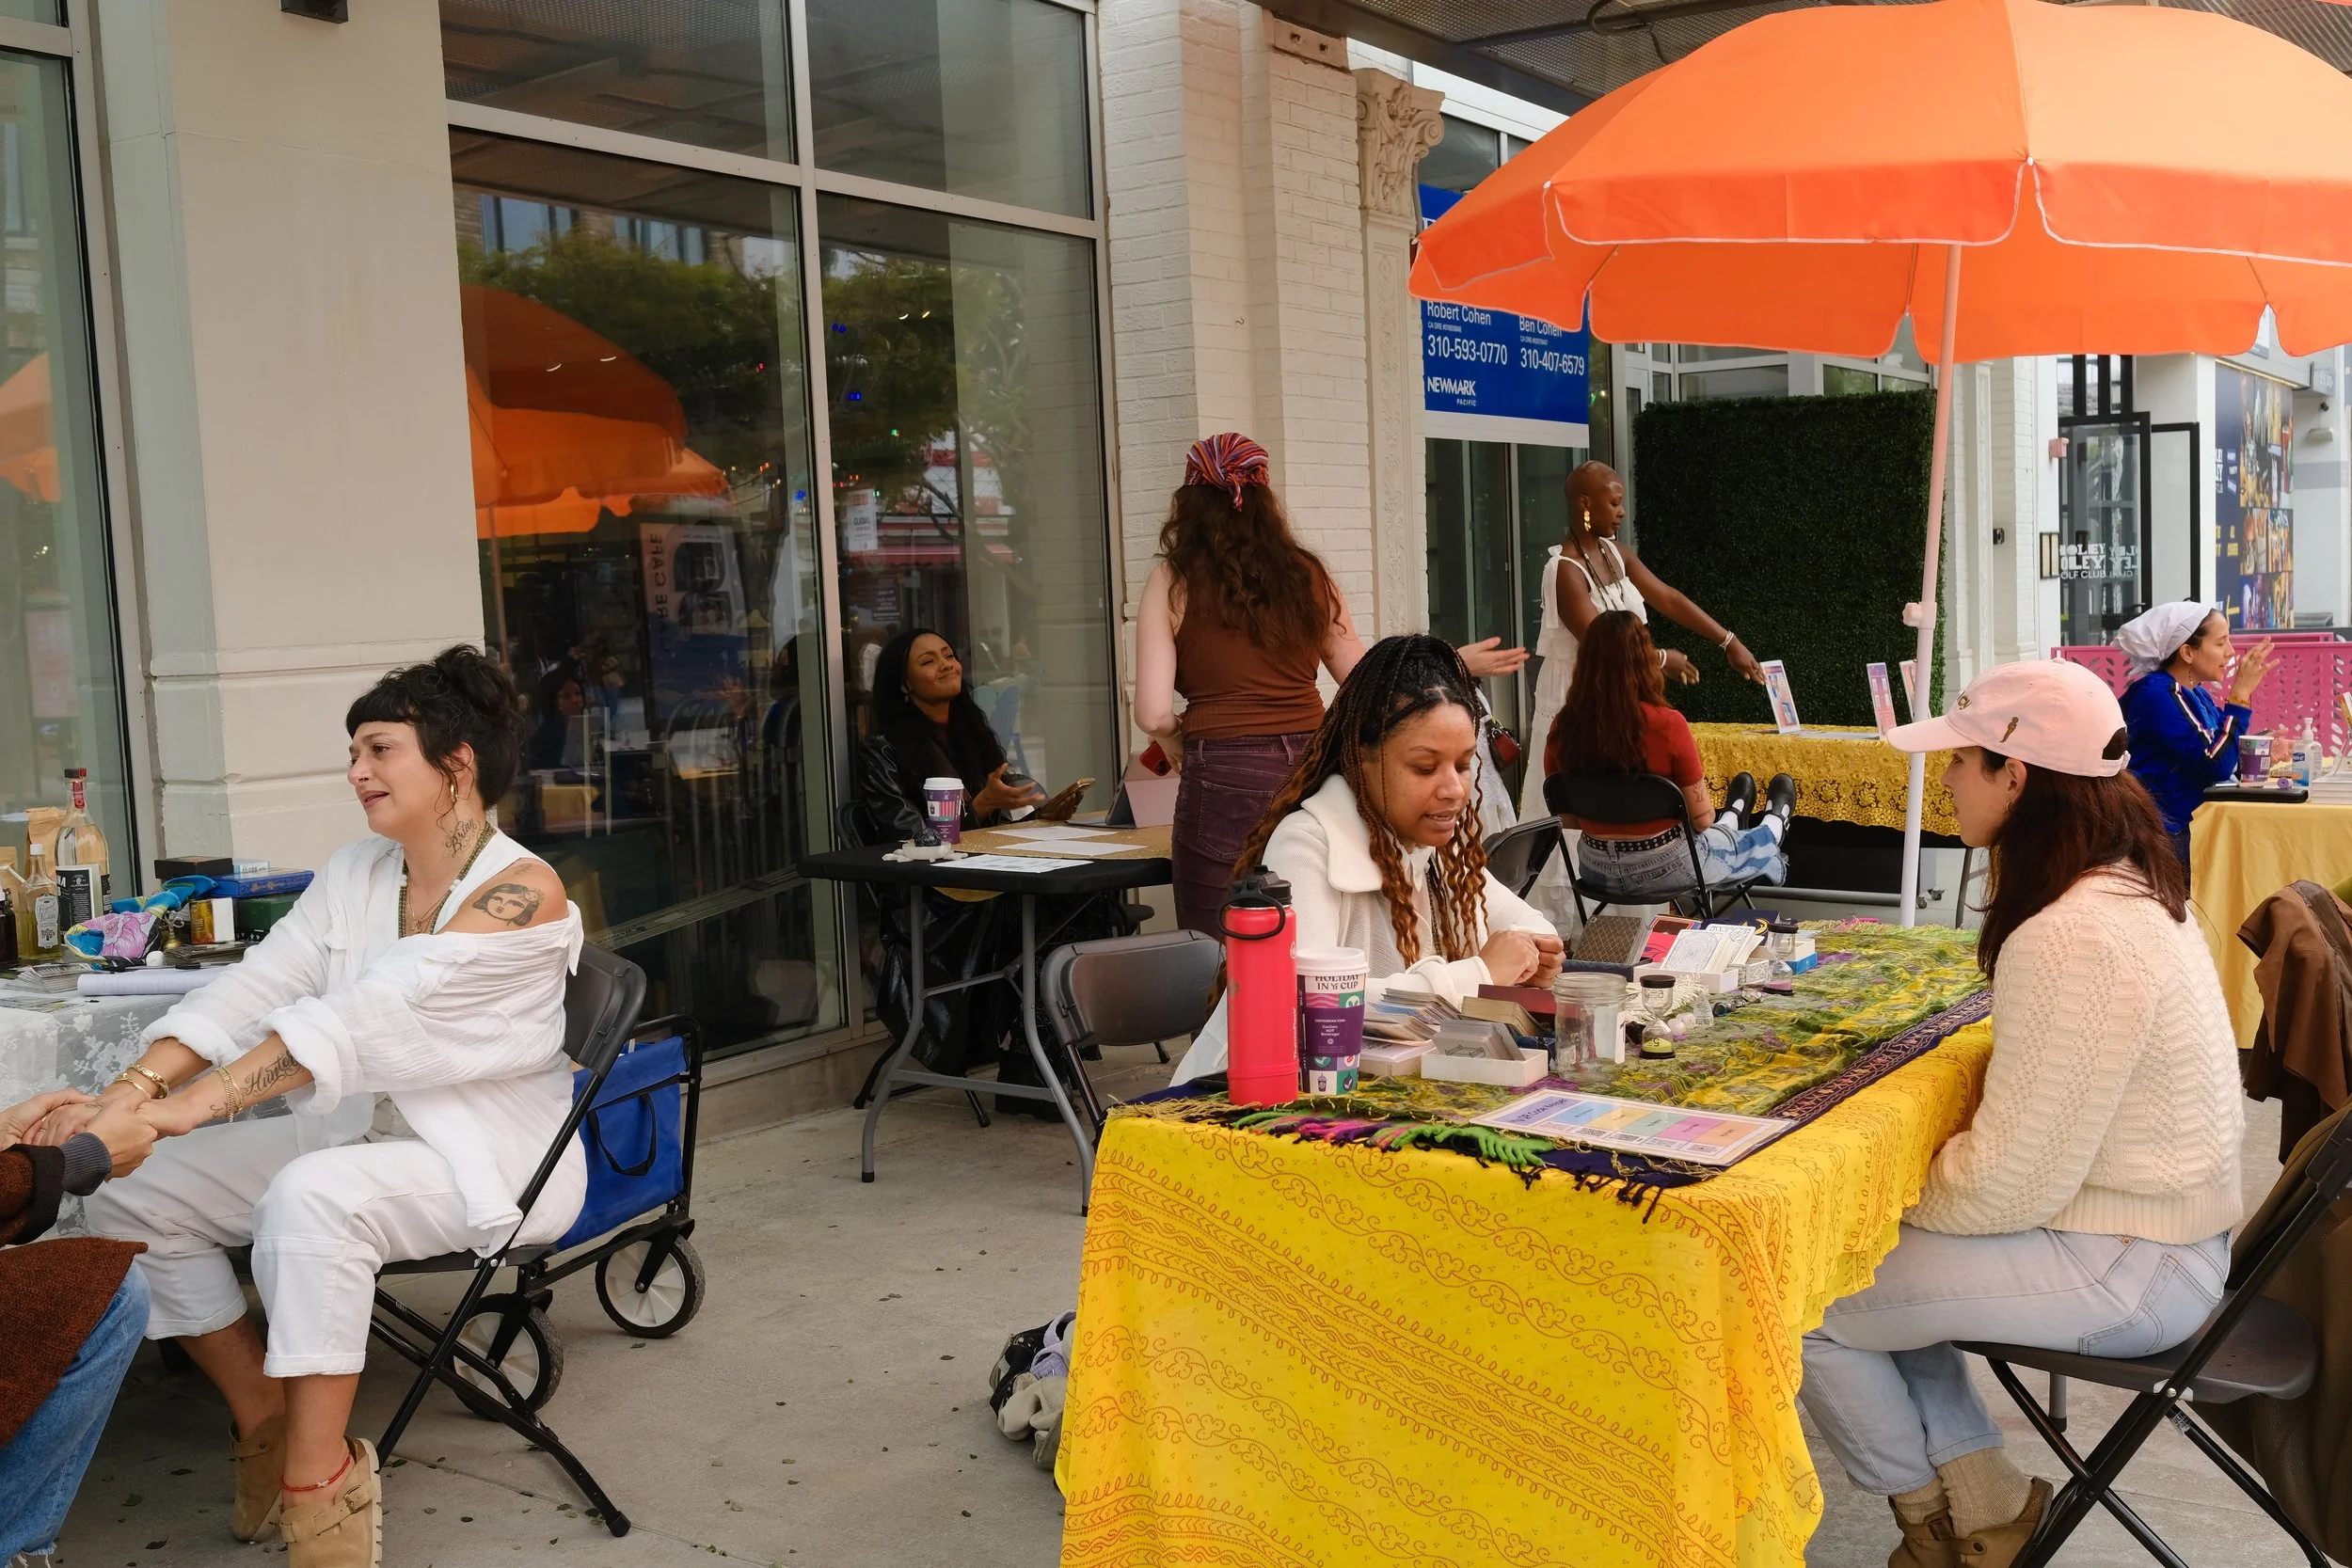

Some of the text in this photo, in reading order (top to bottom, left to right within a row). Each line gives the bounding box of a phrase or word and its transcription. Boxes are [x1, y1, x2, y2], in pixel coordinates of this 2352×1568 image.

[1427, 300, 1491, 325] Robert Cohen
[1519, 316, 1535, 333] Ben
[1428, 334, 1507, 365] 310-593-0770
[1520, 347, 1584, 375] 310-407-6579
[1427, 376, 1476, 396] NEWMARK
[1456, 398, 1477, 406] PACIFIC
[2060, 555, 2106, 570] OLEY
[2060, 570, 2106, 579] OLF CLUB
[1315, 974, 1359, 983] HOLIDAY
[1317, 982, 1329, 990] IN
[1340, 981, 1359, 990] CUP
